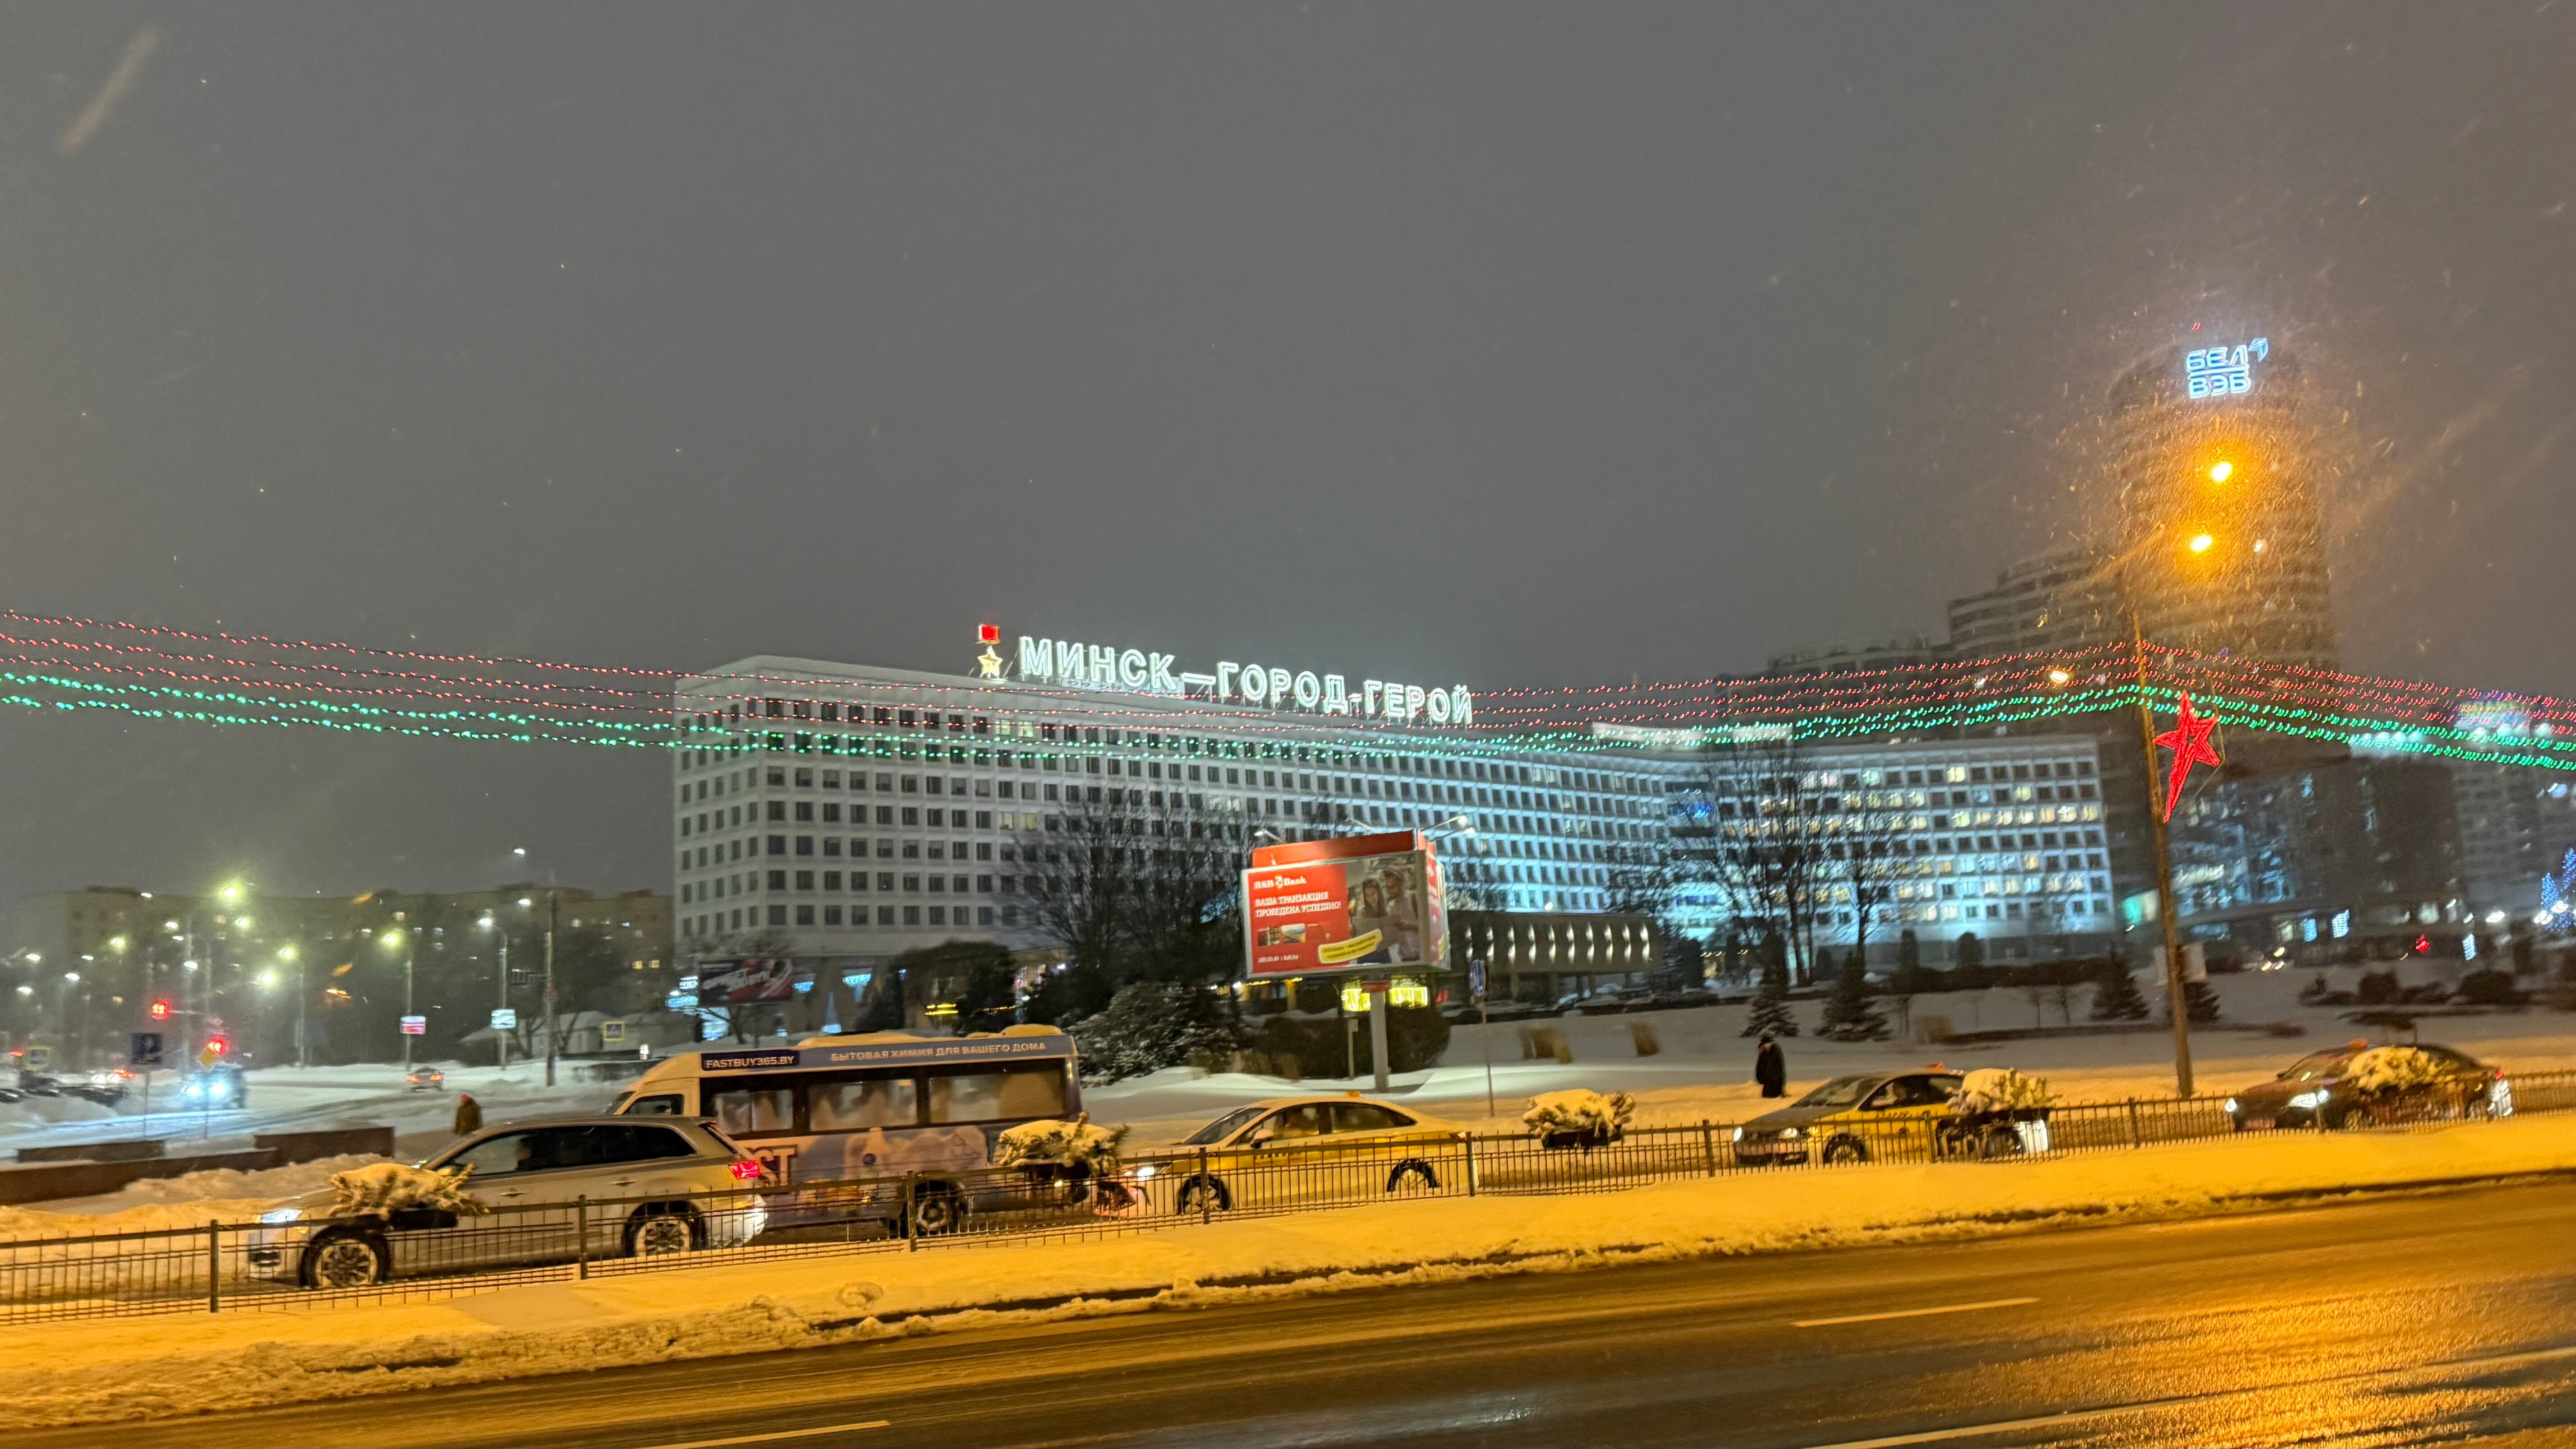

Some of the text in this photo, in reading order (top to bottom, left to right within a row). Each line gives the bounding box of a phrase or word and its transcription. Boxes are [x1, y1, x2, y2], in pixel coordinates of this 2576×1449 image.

[2187, 345, 2248, 372] БЕЛ
[2189, 370, 2251, 399] ВЭБ
[1255, 876, 1306, 889] BSB Bank
[1256, 892, 1329, 907] ВАША ТРАНЗАКЦИЯ
[1256, 901, 1341, 917] ПРОВЕДЕНА УСПЕШНО!
[831, 1043, 1046, 1061] БЫТОВАЯ ХИМИЯ ДЛЯ ВАШЕГО ДОМА
[706, 1056, 794, 1068] FASTBUY365.BY
